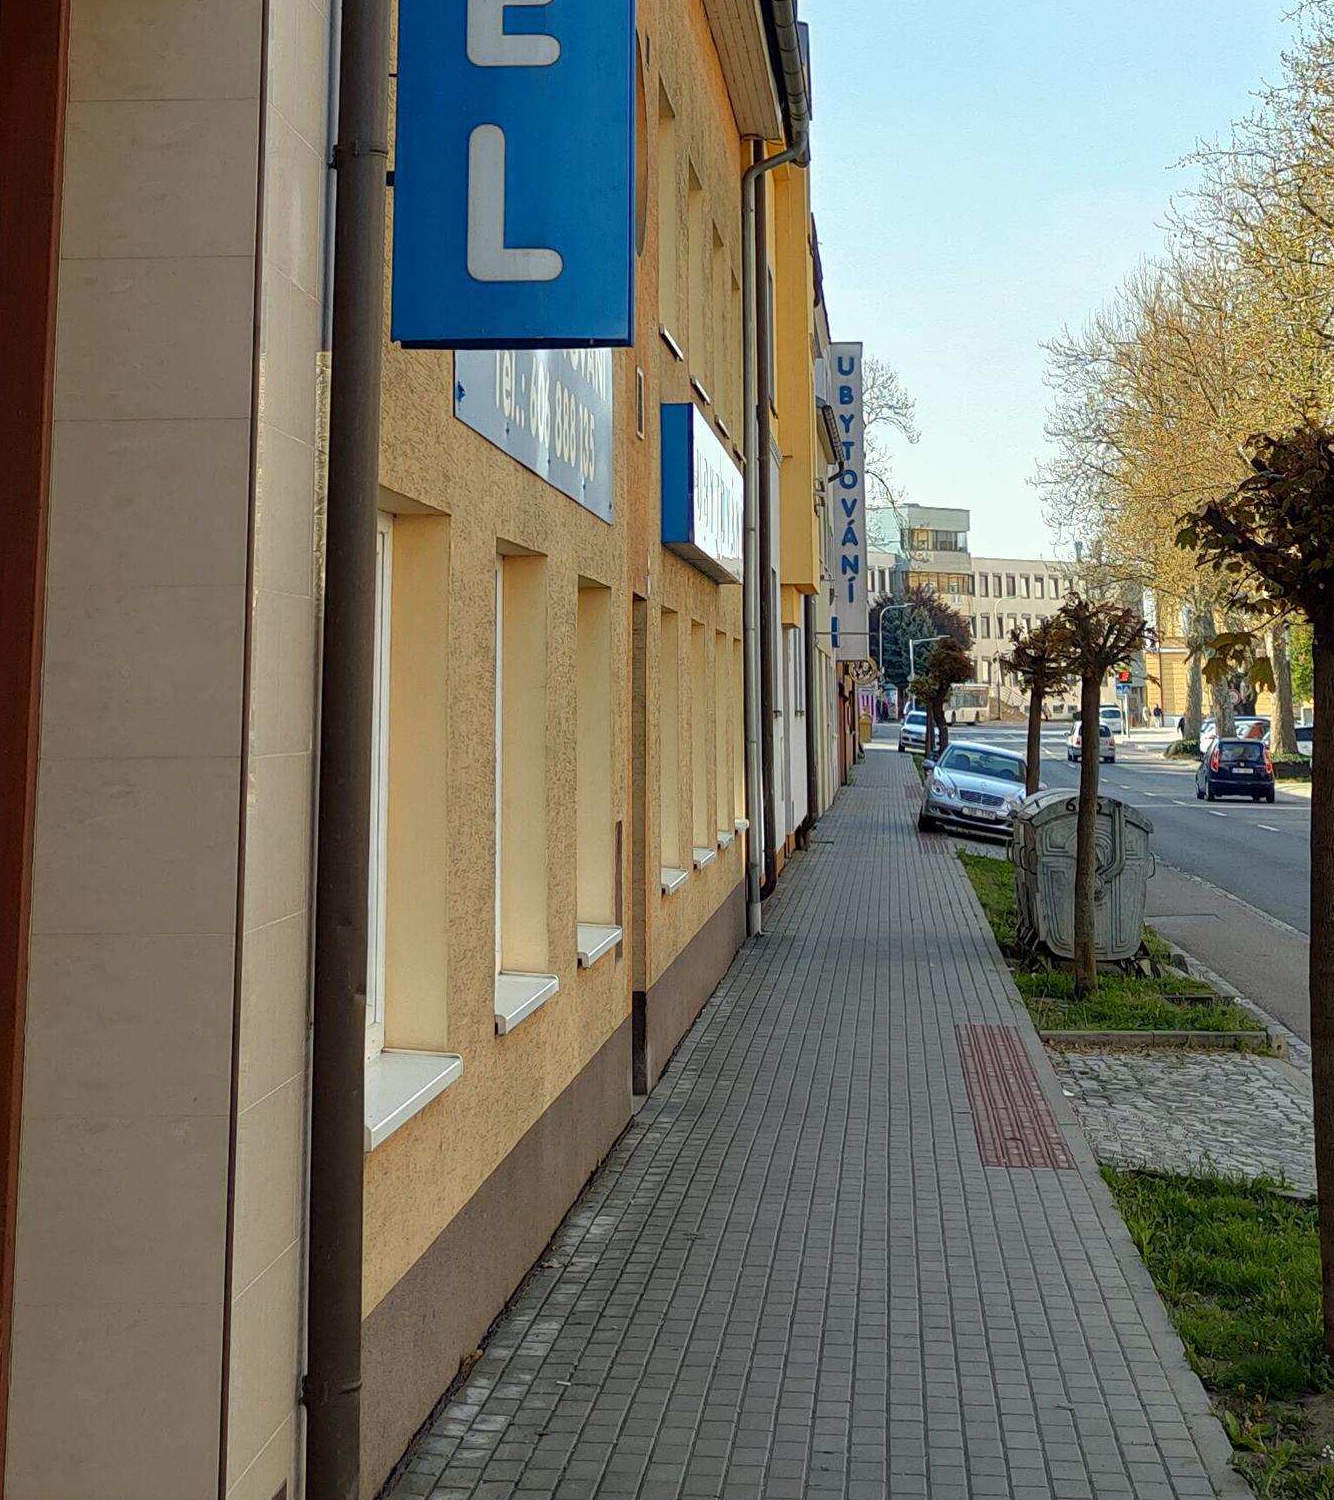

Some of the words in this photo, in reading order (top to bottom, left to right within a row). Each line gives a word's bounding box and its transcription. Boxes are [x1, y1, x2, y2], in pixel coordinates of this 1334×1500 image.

[530, 355, 551, 449] 606
[554, 380, 577, 469] 888
[578, 403, 595, 483] 135
[837, 355, 860, 604] UBYTOVÁNÍ
